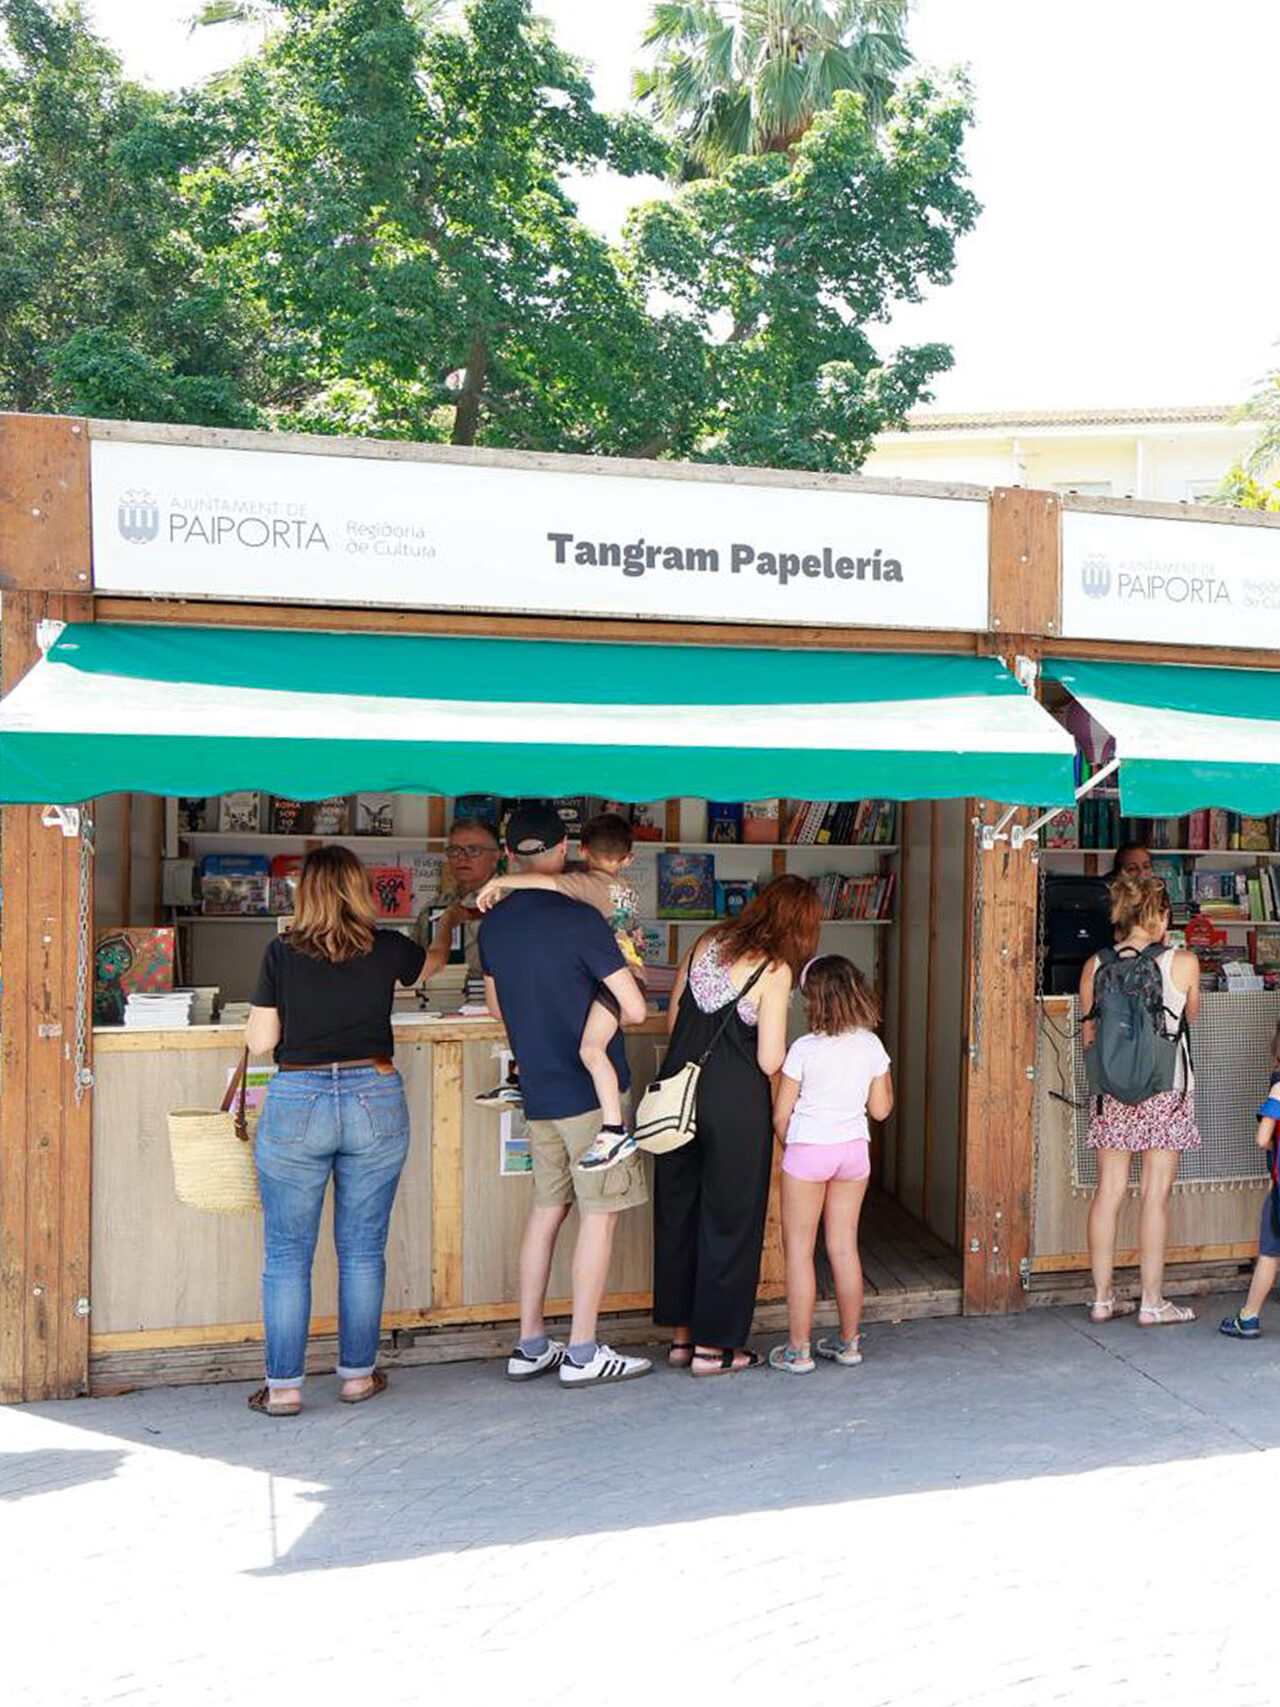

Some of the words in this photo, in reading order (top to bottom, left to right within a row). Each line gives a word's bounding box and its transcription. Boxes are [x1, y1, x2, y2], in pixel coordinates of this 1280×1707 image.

[170, 497, 279, 514] AJUNTAMENT
[286, 503, 308, 517] DE
[169, 514, 329, 550] PAIPORTA
[374, 541, 437, 559] Cultura
[547, 532, 719, 577] Tangram
[731, 543, 904, 585] Papelería
[1118, 573, 1231, 604] PAIPORTA
